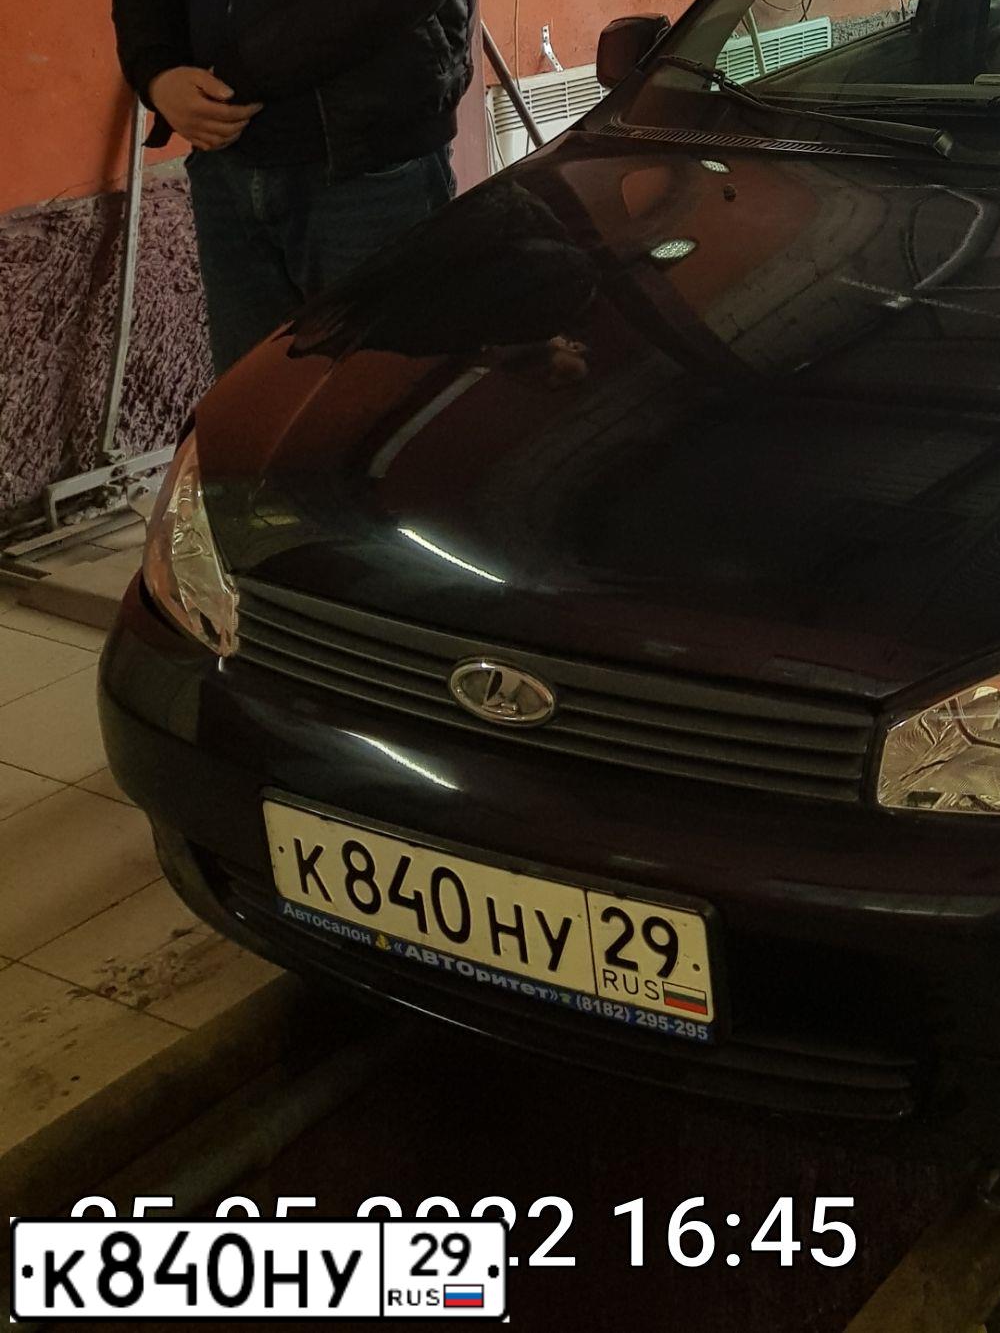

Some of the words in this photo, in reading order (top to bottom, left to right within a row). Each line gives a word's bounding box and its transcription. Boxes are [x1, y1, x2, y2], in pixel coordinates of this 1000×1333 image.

[282, 901, 372, 945] Автосалон
[576, 994, 631, 1024] (8182)
[635, 1009, 709, 1042] 295-295
[293, 837, 573, 972] К840НУ
[600, 905, 680, 978] 29
[602, 969, 661, 1001] RUS
